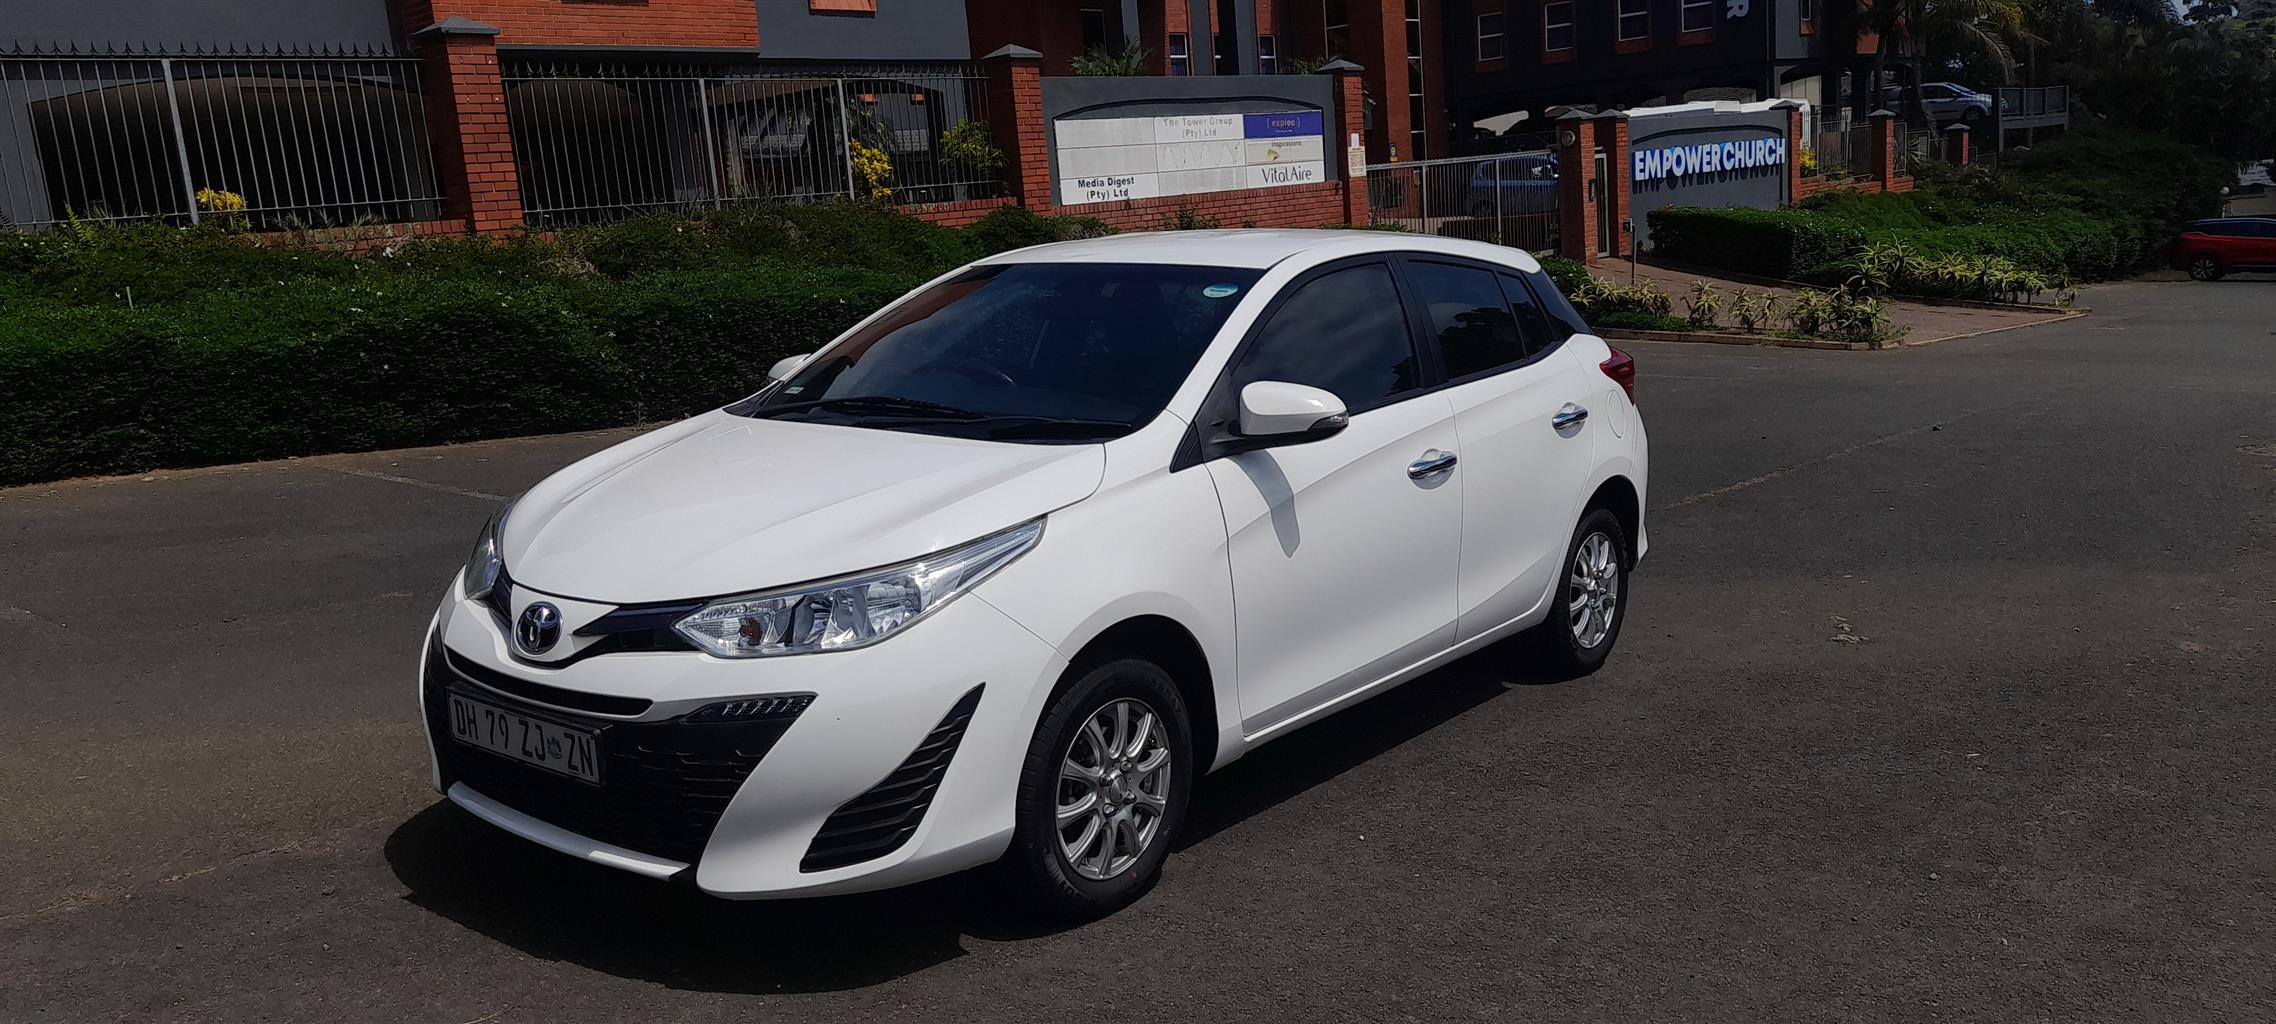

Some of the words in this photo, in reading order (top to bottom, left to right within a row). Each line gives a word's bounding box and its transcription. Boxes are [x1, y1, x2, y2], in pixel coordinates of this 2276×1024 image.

[1209, 117, 1233, 127] Group
[1204, 127, 1217, 137] Ltd
[1078, 178, 1105, 189] Media
[1107, 176, 1135, 188] Digest
[1086, 189, 1110, 201] (Pty)
[1113, 188, 1129, 198] Ltd
[453, 699, 479, 740] DH
[485, 709, 509, 750] 79
[518, 719, 546, 761] ZJ
[564, 731, 595, 777] ZN
